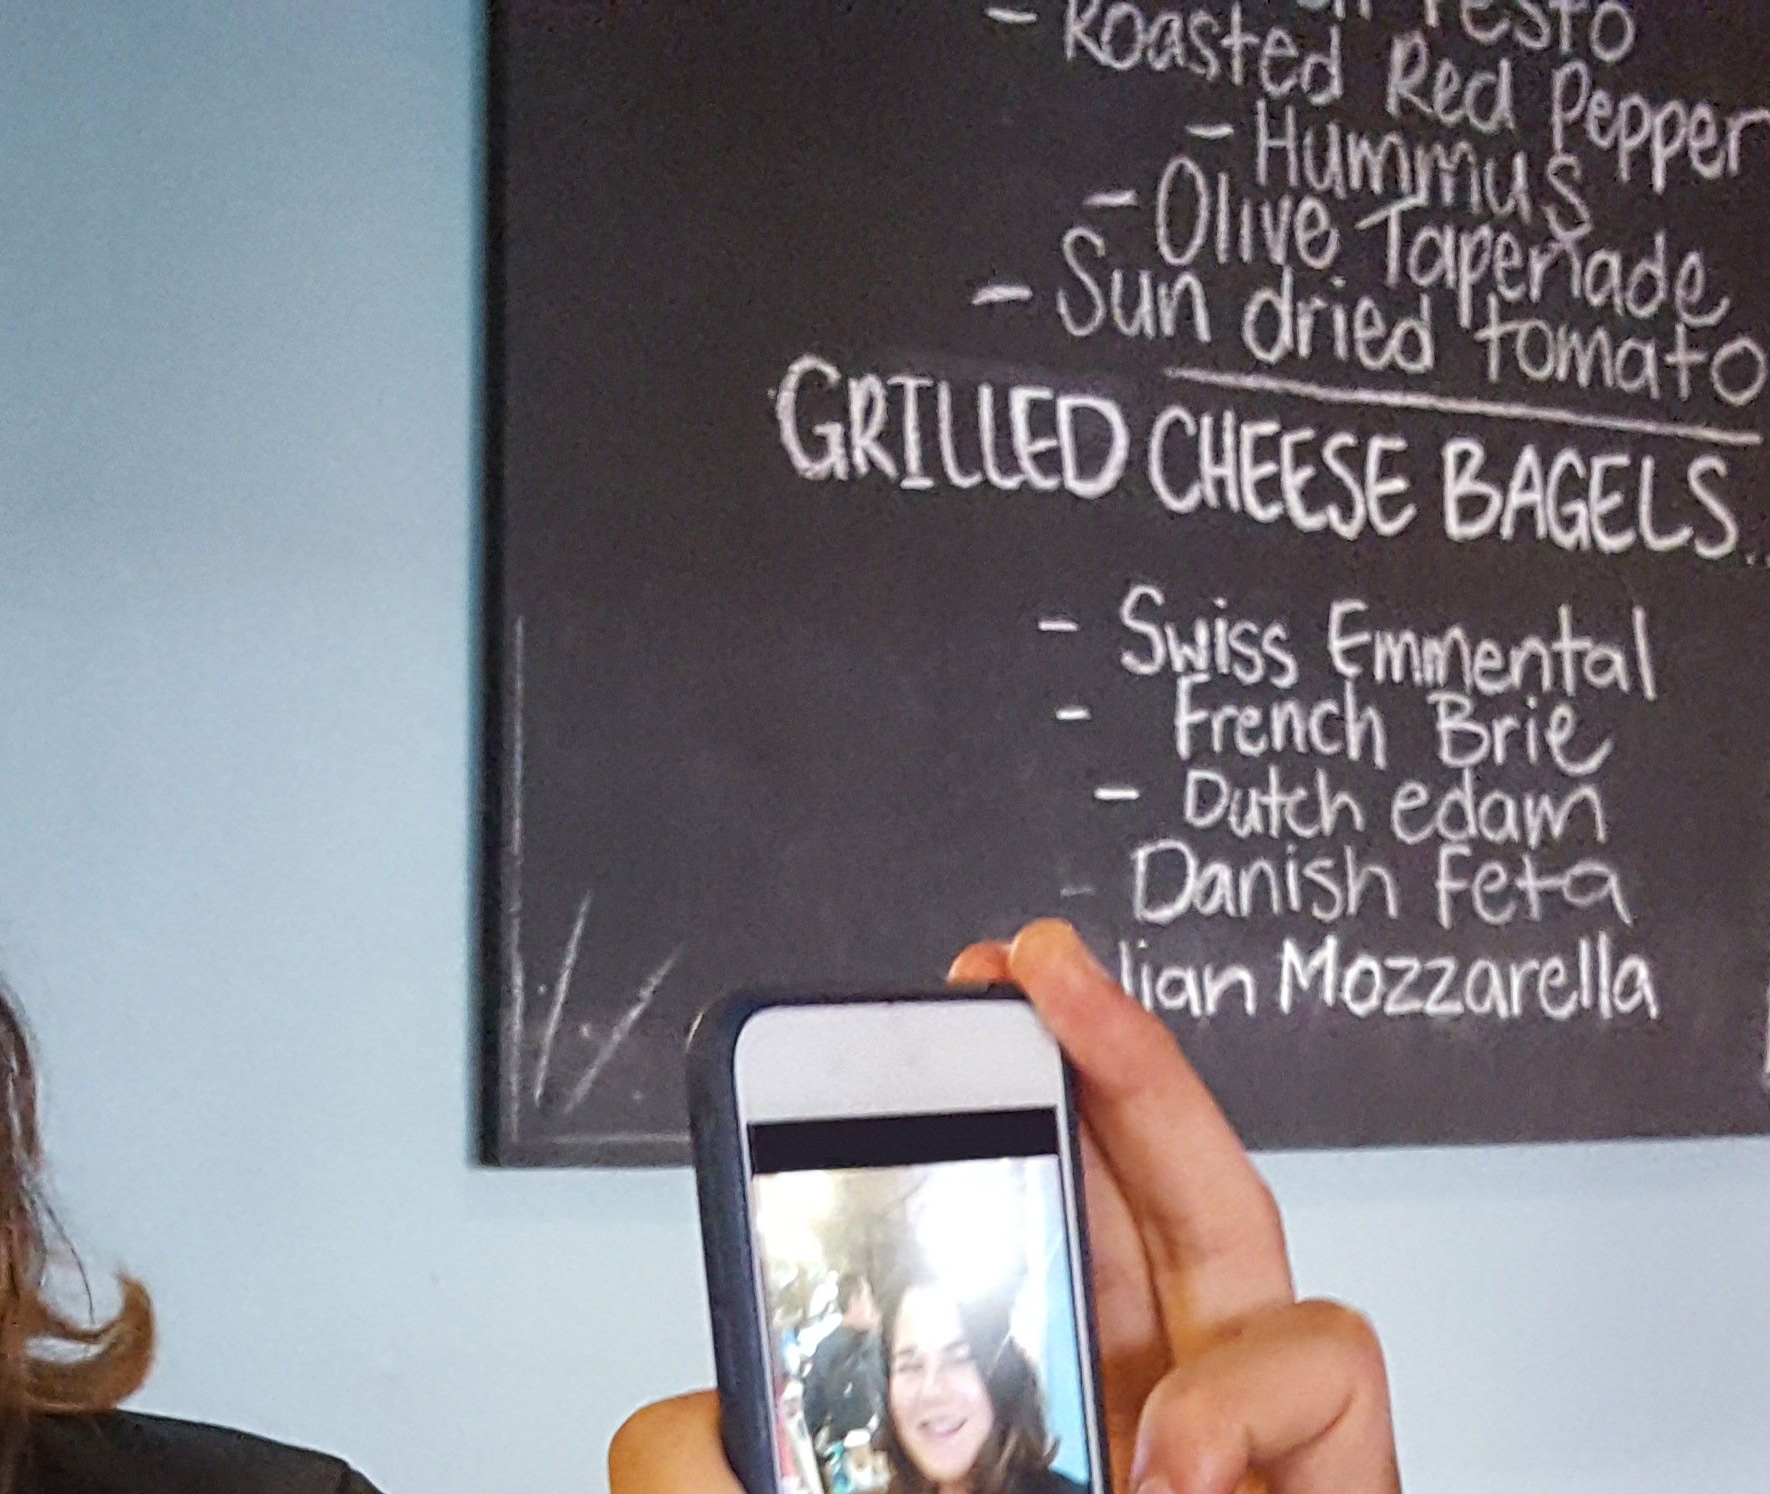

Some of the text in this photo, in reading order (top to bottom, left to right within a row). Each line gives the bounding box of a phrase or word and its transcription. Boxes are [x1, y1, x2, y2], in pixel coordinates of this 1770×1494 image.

[1064, 0, 1343, 105] Roasted
[1386, 31, 1516, 134] Red
[1426, 0, 1635, 62] esto
[1155, 156, 1340, 269] Olive
[1255, 99, 1594, 240] Hummus
[1057, 226, 1768, 405] Sun dried tomato
[776, 354, 1130, 499] GRILLED
[1149, 405, 1418, 542] CHEESE
[1441, 435, 1740, 561] BAGELS
[1120, 585, 1657, 700] Swiss Emmental
[1175, 670, 1613, 775] French Brie
[1183, 764, 1608, 845] Dutch edam
[1131, 839, 1400, 924] Danish
[1118, 932, 1659, 1021] lian Mozzarella
